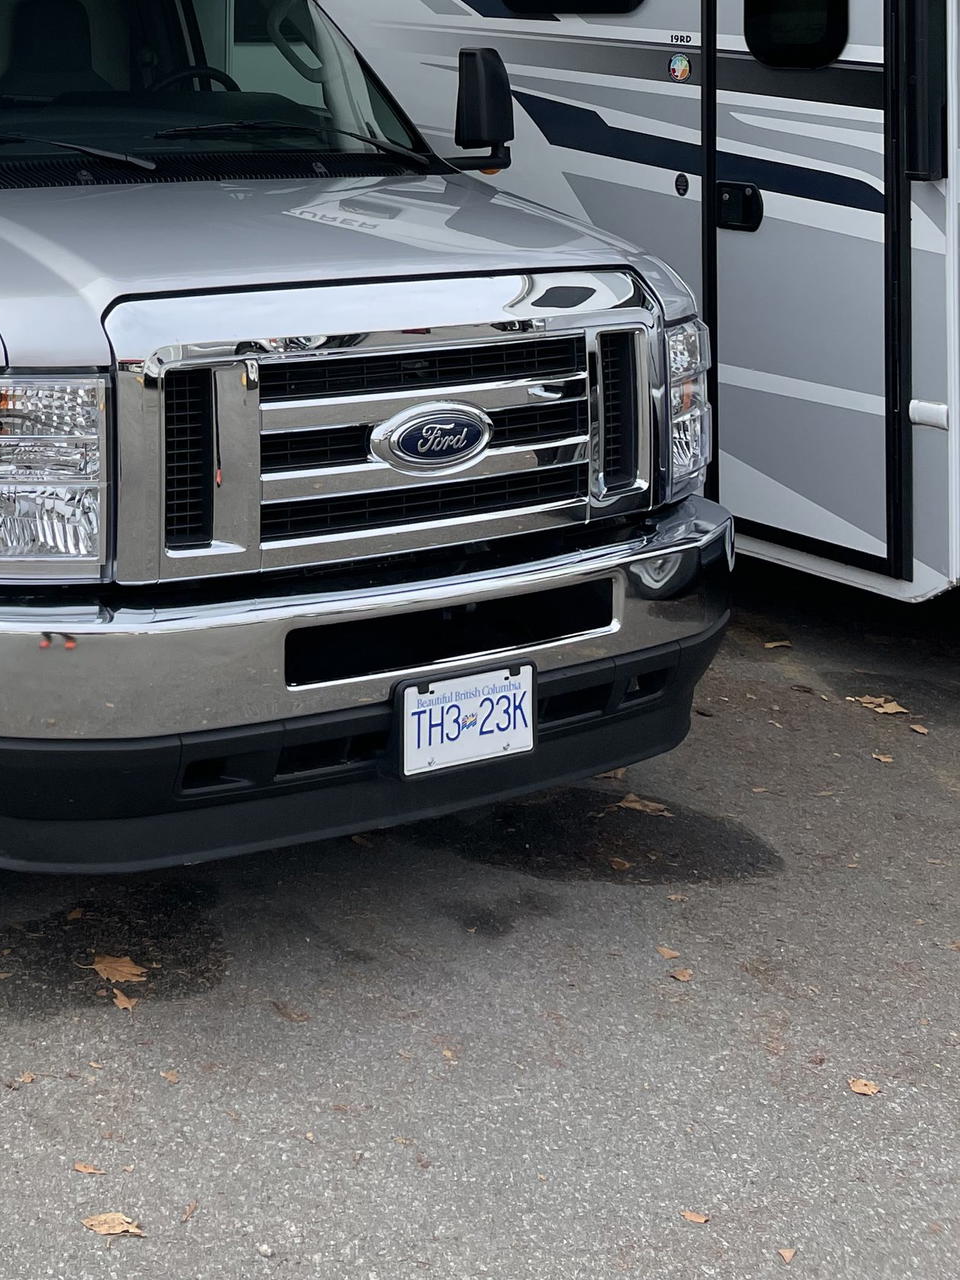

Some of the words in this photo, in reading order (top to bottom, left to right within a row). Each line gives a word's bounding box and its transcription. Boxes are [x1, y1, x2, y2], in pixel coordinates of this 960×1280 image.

[670, 34, 692, 43] 19RD
[417, 423, 468, 453] Ford
[416, 691, 453, 710] Beautiful
[454, 687, 480, 702] British
[481, 682, 521, 696] Columbia
[411, 703, 462, 749] TH3
[479, 691, 528, 735] 23K
